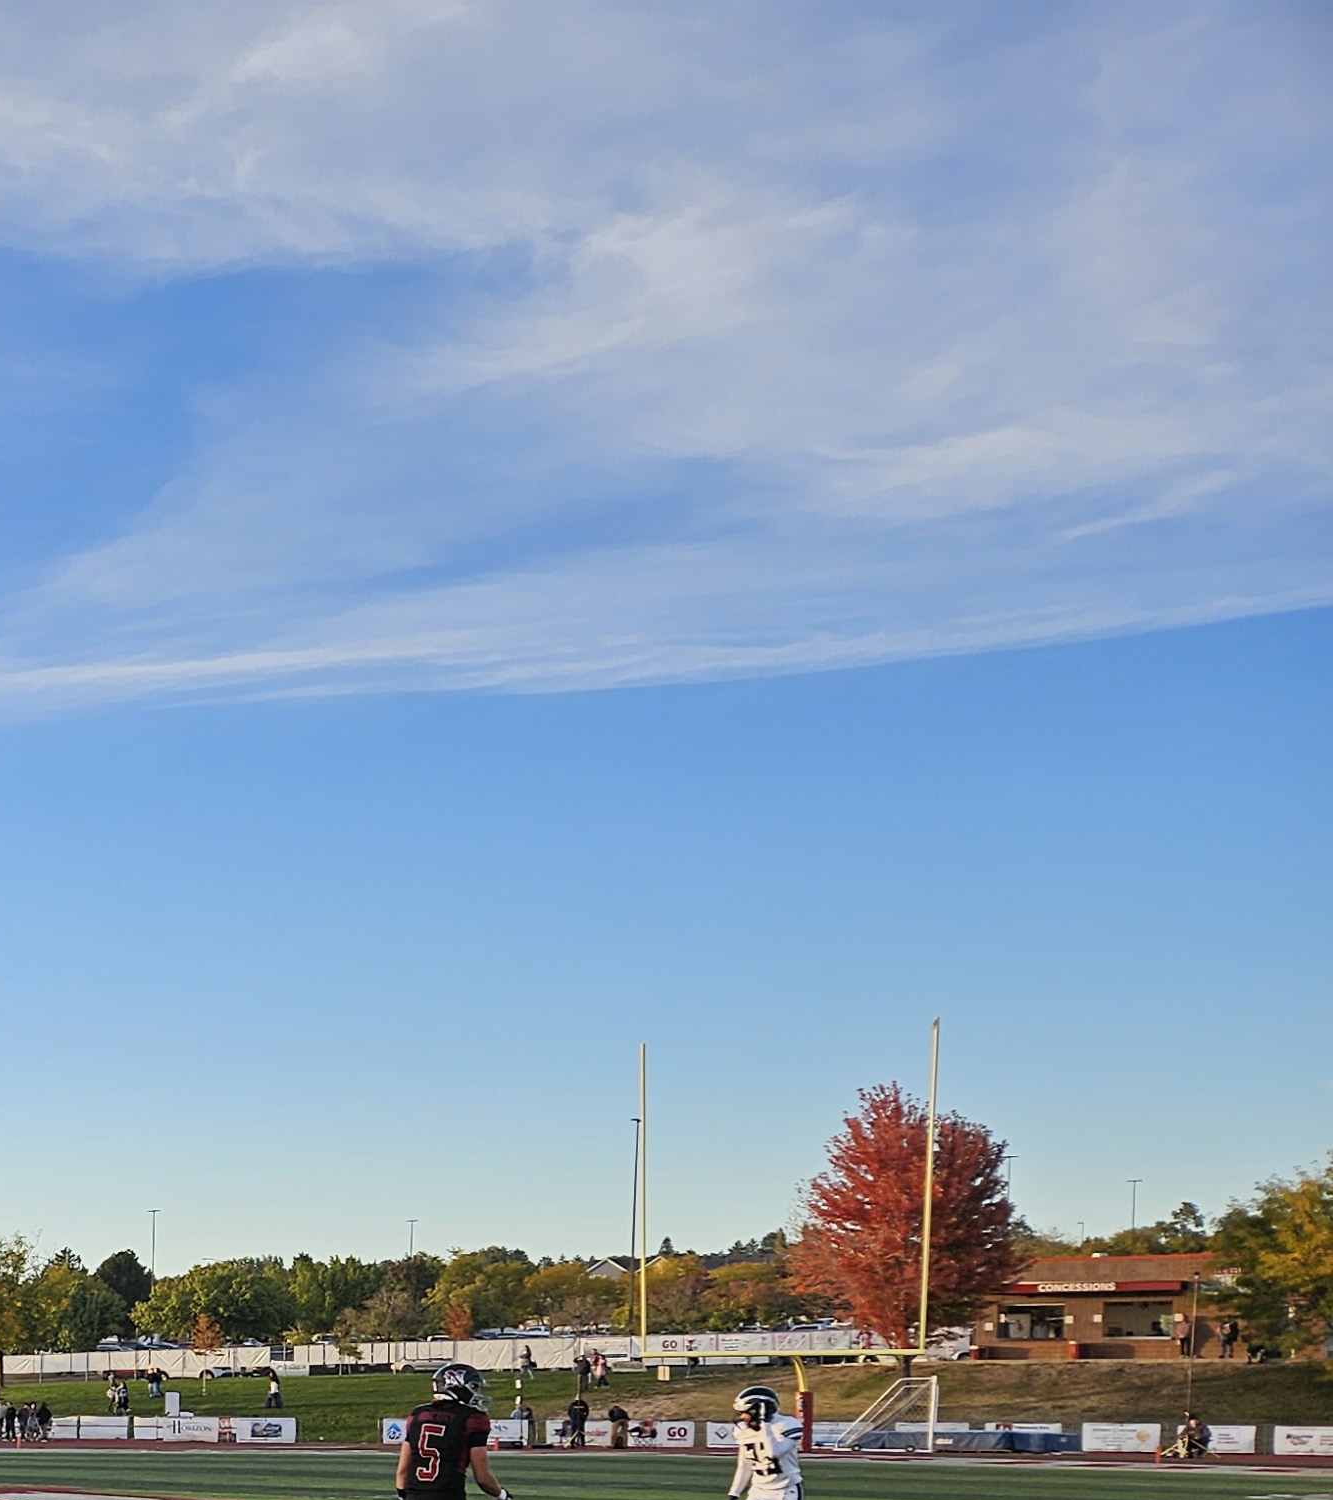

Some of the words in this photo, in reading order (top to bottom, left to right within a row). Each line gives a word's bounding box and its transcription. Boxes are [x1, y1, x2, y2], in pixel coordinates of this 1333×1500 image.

[1037, 1282, 1116, 1293] CONCESSIONS
[662, 1339, 677, 1349] GO
[171, 1419, 212, 1434] HORIZON
[667, 1426, 688, 1437] GO
[416, 1424, 446, 1481] 5
